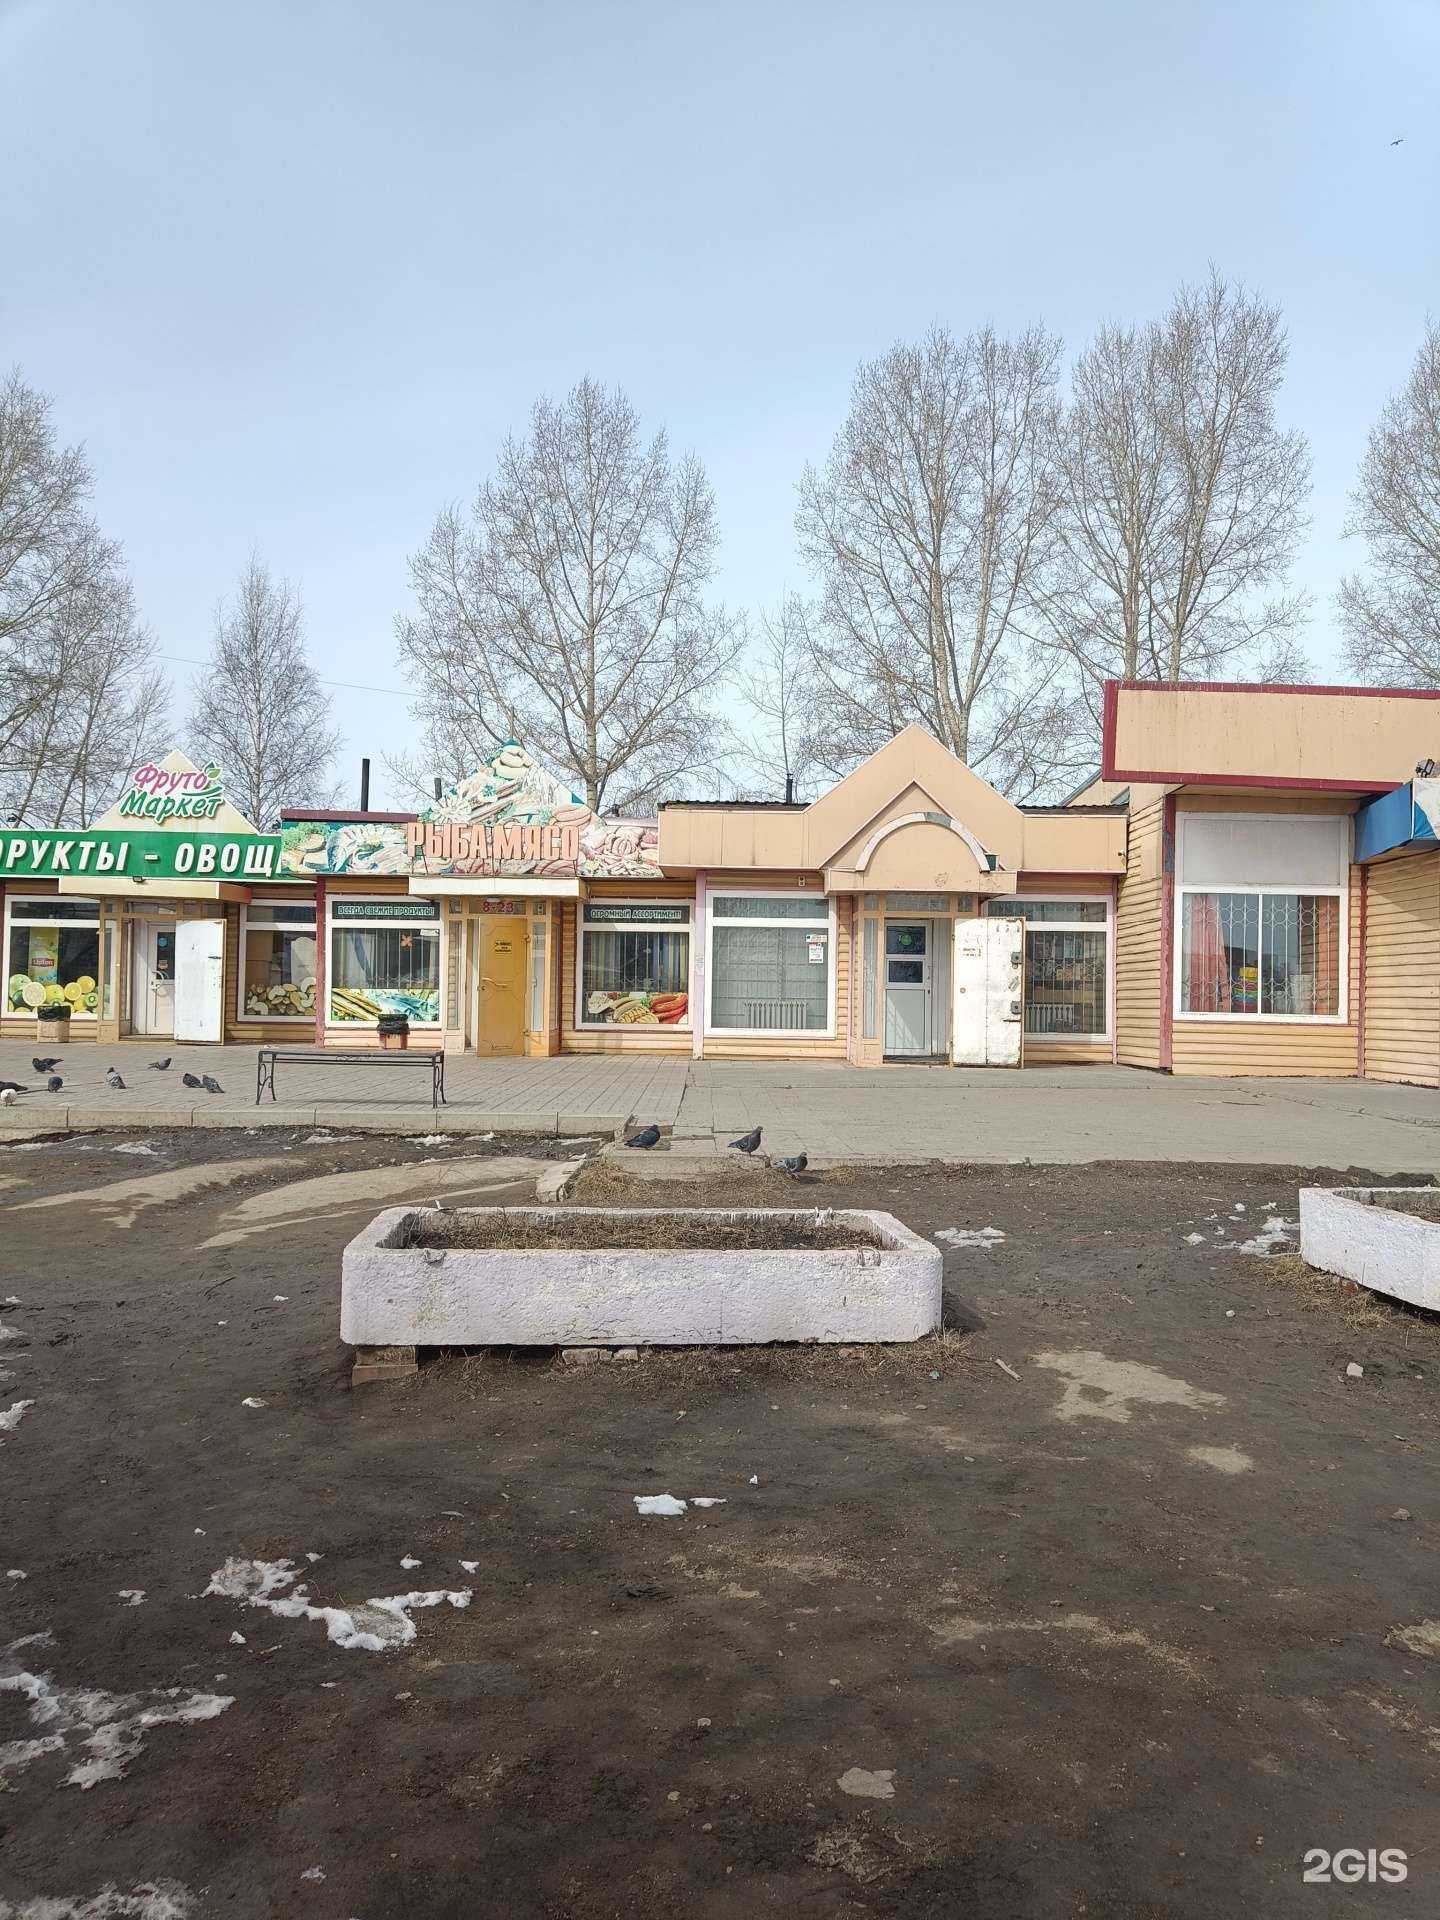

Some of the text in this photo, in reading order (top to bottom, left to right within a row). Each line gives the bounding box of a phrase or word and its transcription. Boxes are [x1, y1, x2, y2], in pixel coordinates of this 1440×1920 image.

[133, 764, 208, 796] Фруто
[120, 789, 222, 822] Маркет
[0, 838, 129, 871] РУКТЫ
[175, 843, 281, 877] ОВОЩ
[337, 905, 364, 915] ВСЕГДА
[365, 905, 393, 916] СВЕЖИЕ
[591, 908, 631, 919] ОГРОМНЫЙ
